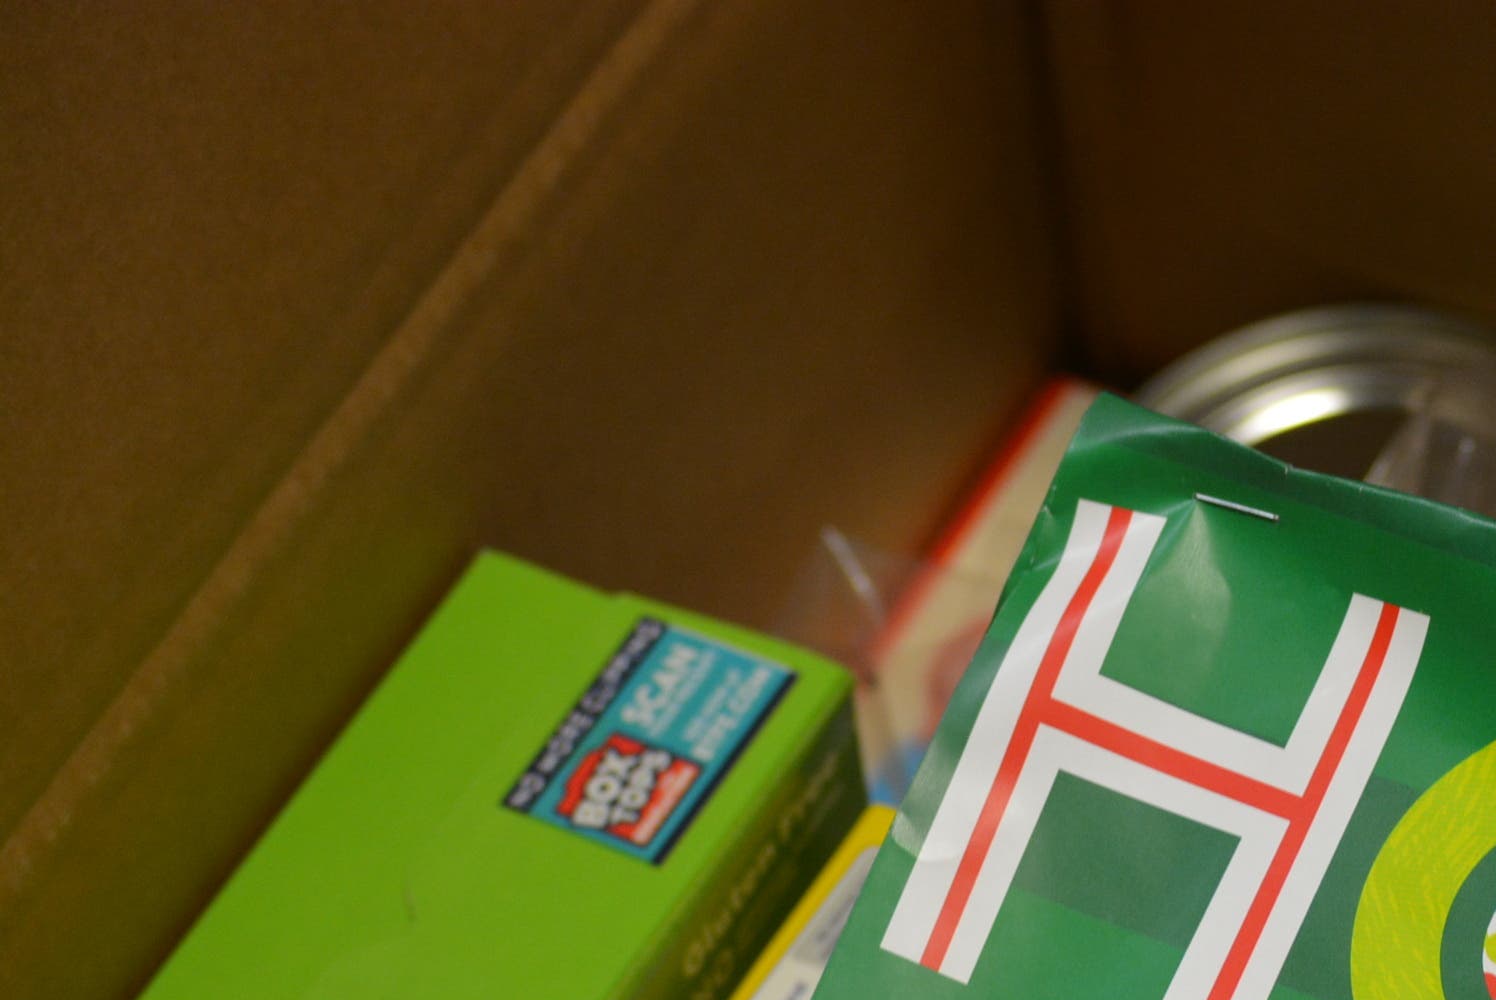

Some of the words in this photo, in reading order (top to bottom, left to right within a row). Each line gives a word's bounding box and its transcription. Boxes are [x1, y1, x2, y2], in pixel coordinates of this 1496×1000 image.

[620, 643, 697, 724] SCAN
[571, 748, 638, 828] BOX
[609, 749, 672, 823] TOPS
